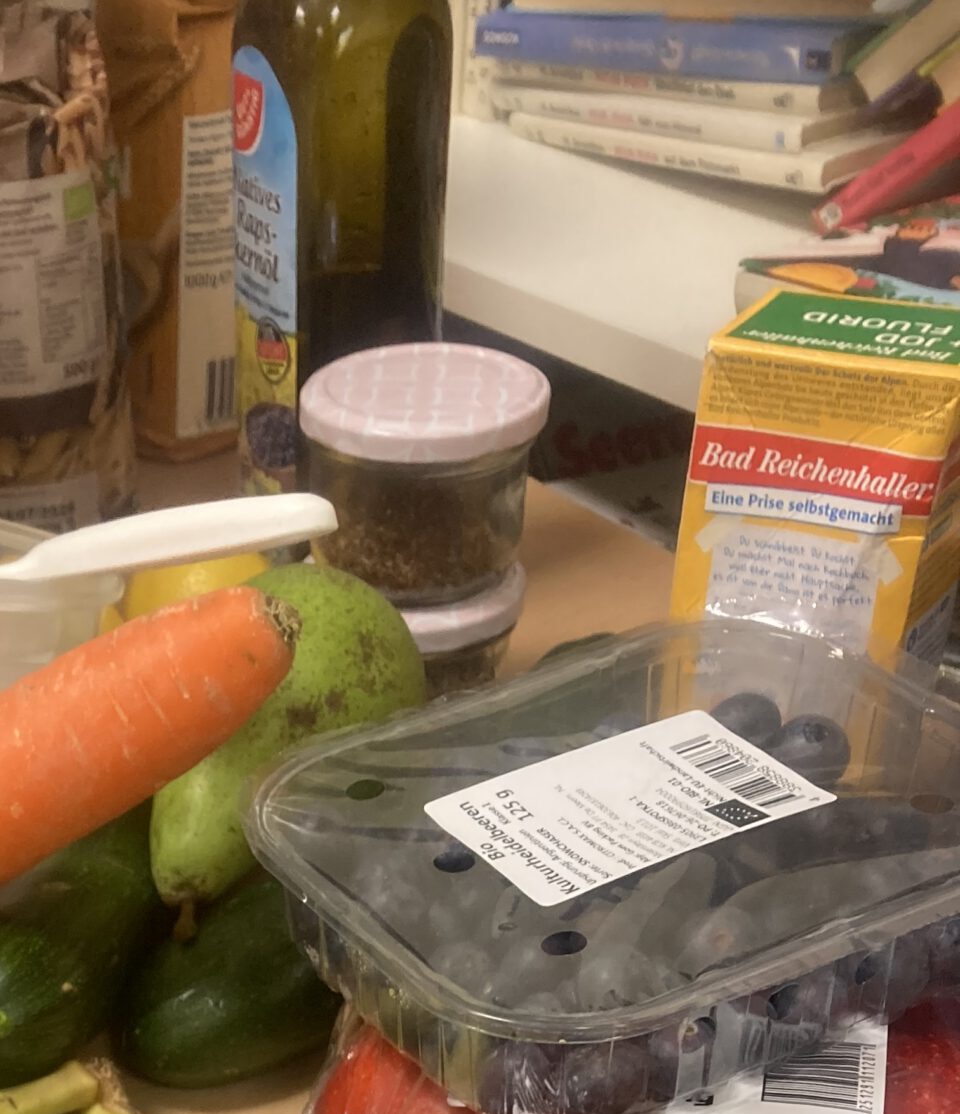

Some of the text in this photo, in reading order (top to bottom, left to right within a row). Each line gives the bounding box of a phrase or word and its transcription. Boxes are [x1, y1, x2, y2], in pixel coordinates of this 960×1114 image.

[803, 310, 954, 337] FLUORID
[874, 331, 943, 348] JOD
[698, 441, 753, 473] Bad
[757, 447, 934, 502] Reichenhaller
[711, 490, 895, 527] Eine Prise selbstgemacht
[492, 788, 516, 799] g
[498, 799, 536, 822] 125
[454, 800, 581, 895] Kulturheidelbeeren
[474, 840, 507, 861] Bio
